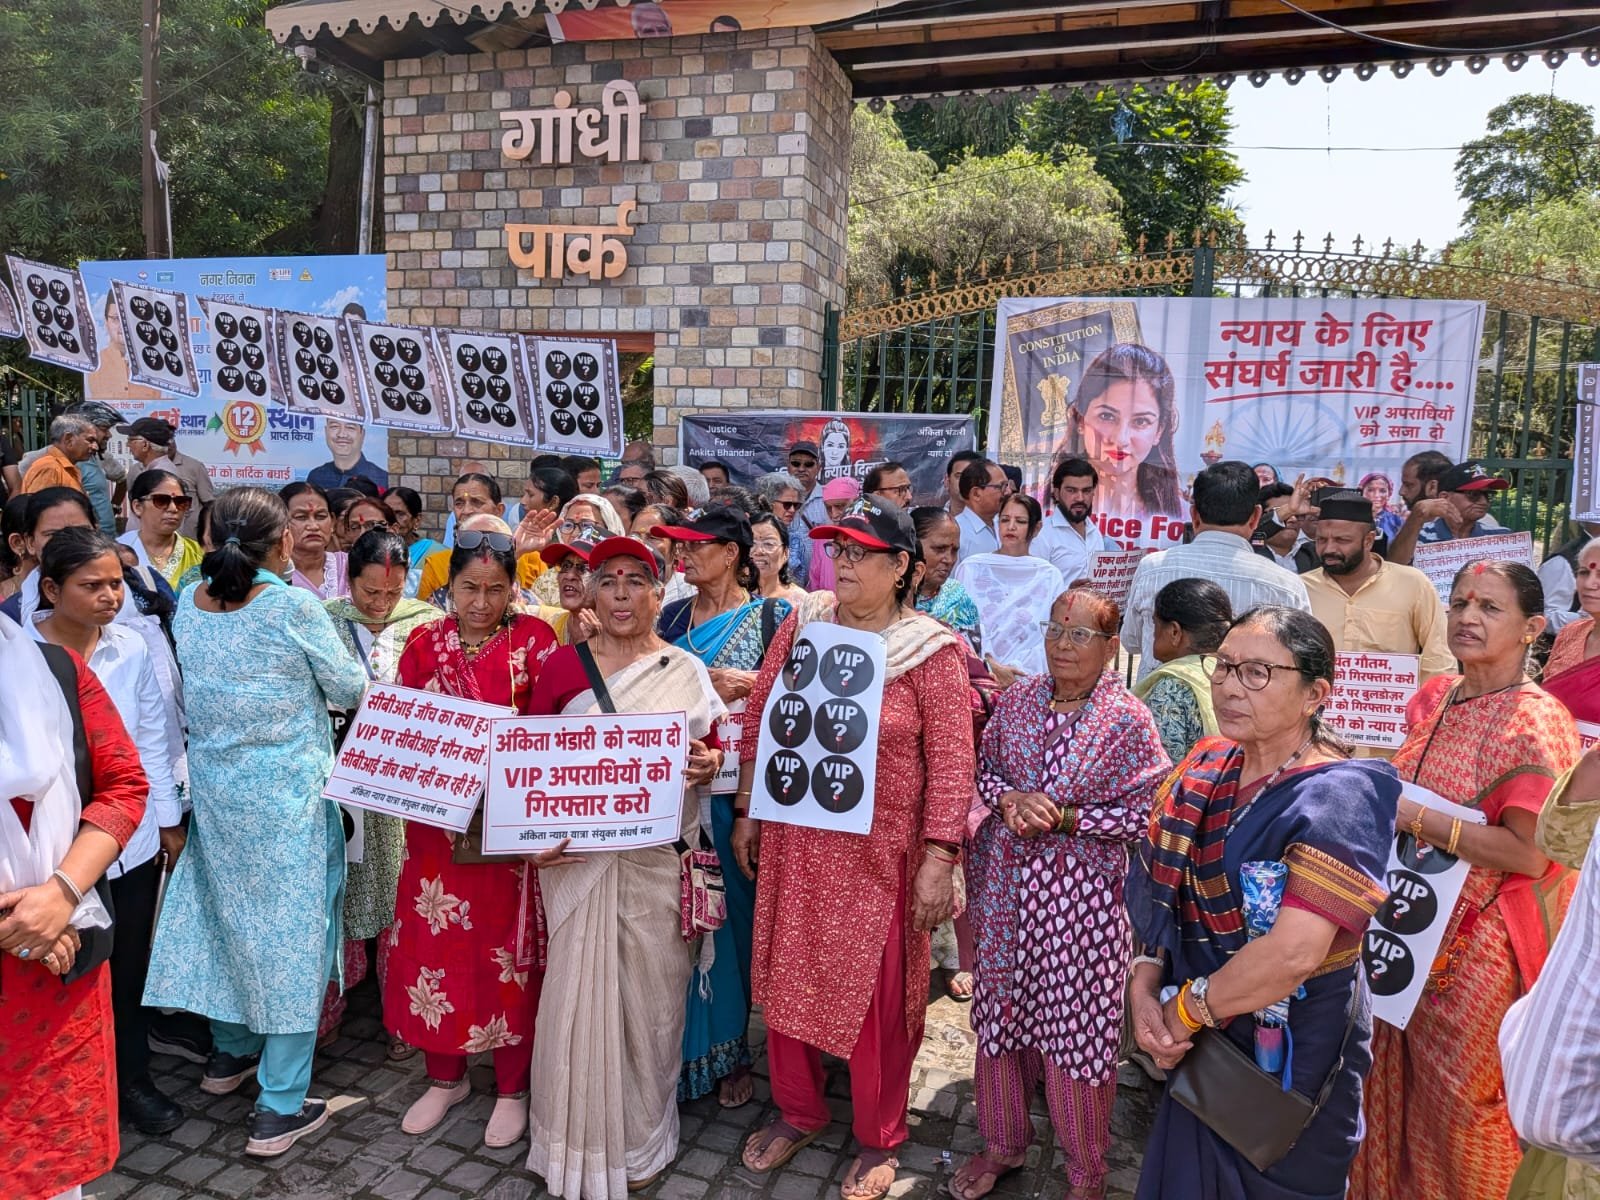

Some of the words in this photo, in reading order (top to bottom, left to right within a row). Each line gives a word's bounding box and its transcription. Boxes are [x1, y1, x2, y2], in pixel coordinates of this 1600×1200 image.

[500, 80, 647, 164] गांधी
[505, 200, 638, 280] पार्क
[200, 274, 224, 286] नगर
[226, 270, 256, 286] निगम
[218, 314, 234, 324] VIP
[244, 319, 258, 328] VIP
[1221, 320, 1306, 347] न्याय
[1315, 312, 1353, 347] के
[1362, 312, 1433, 352] लिए
[374, 337, 390, 346] VIP
[400, 340, 416, 348] VIP
[1018, 324, 1103, 354] CONSTITUTION
[221, 341, 236, 350] VIP
[246, 346, 260, 355] VIP
[460, 346, 476, 355] VIP
[1054, 344, 1066, 353] OF
[300, 350, 312, 360] VIP
[486, 350, 502, 358] VIP
[550, 354, 566, 362] VIP
[577, 356, 594, 364] VIP
[1042, 352, 1080, 368] INDIA
[223, 369, 240, 378] VIP
[378, 364, 394, 374] VIP
[404, 368, 419, 376] VIP
[1204, 350, 1292, 390] संघर्ष
[1300, 351, 1380, 389] जारी
[249, 372, 262, 382] VIP
[302, 376, 316, 386] VIP
[464, 375, 480, 384] VIP
[490, 378, 506, 387] VIP
[324, 382, 338, 391] VIP
[550, 384, 567, 392] VIP
[578, 386, 594, 396] VIP
[384, 390, 400, 398] VIP
[410, 394, 424, 402] VIP
[469, 402, 484, 410] VIP
[494, 406, 509, 414] VIP
[1354, 406, 1380, 420] VIP
[1385, 402, 1455, 421] अपराधियों
[181, 416, 206, 428] स्थान
[232, 406, 254, 426] 12
[267, 408, 314, 430] स्थान
[554, 412, 570, 420] VIP
[581, 414, 597, 422] VIP
[270, 431, 288, 440] प्राप्त
[292, 429, 313, 440] किया
[706, 424, 737, 433] Justice
[917, 426, 944, 436] अंकिता
[1360, 420, 1380, 438] को
[1388, 426, 1420, 438] सजा
[1429, 424, 1445, 440] दो
[714, 438, 728, 446] For
[936, 438, 946, 446] को
[689, 448, 715, 456] Ankita
[718, 448, 755, 456] Bhandari
[220, 466, 232, 478] को
[236, 466, 264, 478] हार्दिक
[824, 464, 852, 478] न्याय
[1150, 516, 1184, 542] Fo
[1093, 568, 1107, 578] VIP
[791, 646, 811, 660] VIP
[833, 649, 864, 668] VIP
[1335, 655, 1351, 668] यंत
[1349, 668, 1392, 683] गिरफ्तार
[1394, 672, 1415, 684] करो
[1347, 688, 1359, 698] पर
[1362, 688, 1404, 701] बुलडोज़र
[368, 692, 417, 720] सीबीआई
[414, 701, 438, 722] जाँच
[438, 709, 455, 726] का
[454, 712, 476, 730] क्या
[779, 700, 804, 716] VIP
[1336, 698, 1348, 710] को
[1351, 699, 1392, 713] गिरफ्तार
[825, 704, 858, 720] VIP
[1349, 716, 1364, 730] को
[1368, 722, 1396, 732] न्याय
[356, 722, 380, 741] VIP
[380, 728, 396, 746] पर
[395, 728, 442, 758] सीबीआई
[440, 737, 463, 760] मौन
[496, 727, 551, 752] अंकिता
[554, 725, 596, 750] भंडारी
[603, 725, 624, 750] को
[628, 728, 662, 748] न्याय
[666, 722, 682, 748] दो
[774, 756, 800, 772] VIP
[341, 747, 382, 777] सीबीआई
[379, 757, 400, 778] जाँच
[398, 763, 420, 782] क्यों
[418, 766, 438, 789] नहीं
[434, 772, 452, 790] कर
[450, 773, 468, 796] रही
[464, 774, 482, 798] है?
[504, 766, 542, 788] VIP
[548, 757, 642, 786] अपराधियों
[646, 756, 672, 782] को
[822, 762, 854, 780] VIP
[350, 786, 370, 798] अंकिता
[370, 790, 386, 802] न्याय
[386, 794, 401, 806] यात्रा
[400, 798, 420, 812] संयुक्त
[420, 802, 437, 815] संघर्ष
[436, 805, 448, 816] मंच
[525, 790, 608, 818] गिरफ्तार
[614, 786, 652, 814] करो
[518, 830, 546, 841] अंकिता
[549, 830, 568, 839] न्याय
[570, 830, 588, 840] यात्रा
[592, 828, 616, 842] संयुक्त
[620, 827, 638, 837] संघर्ष
[640, 826, 652, 836] मंच
[1390, 874, 1428, 900] VIP
[1368, 933, 1406, 960] VIP
